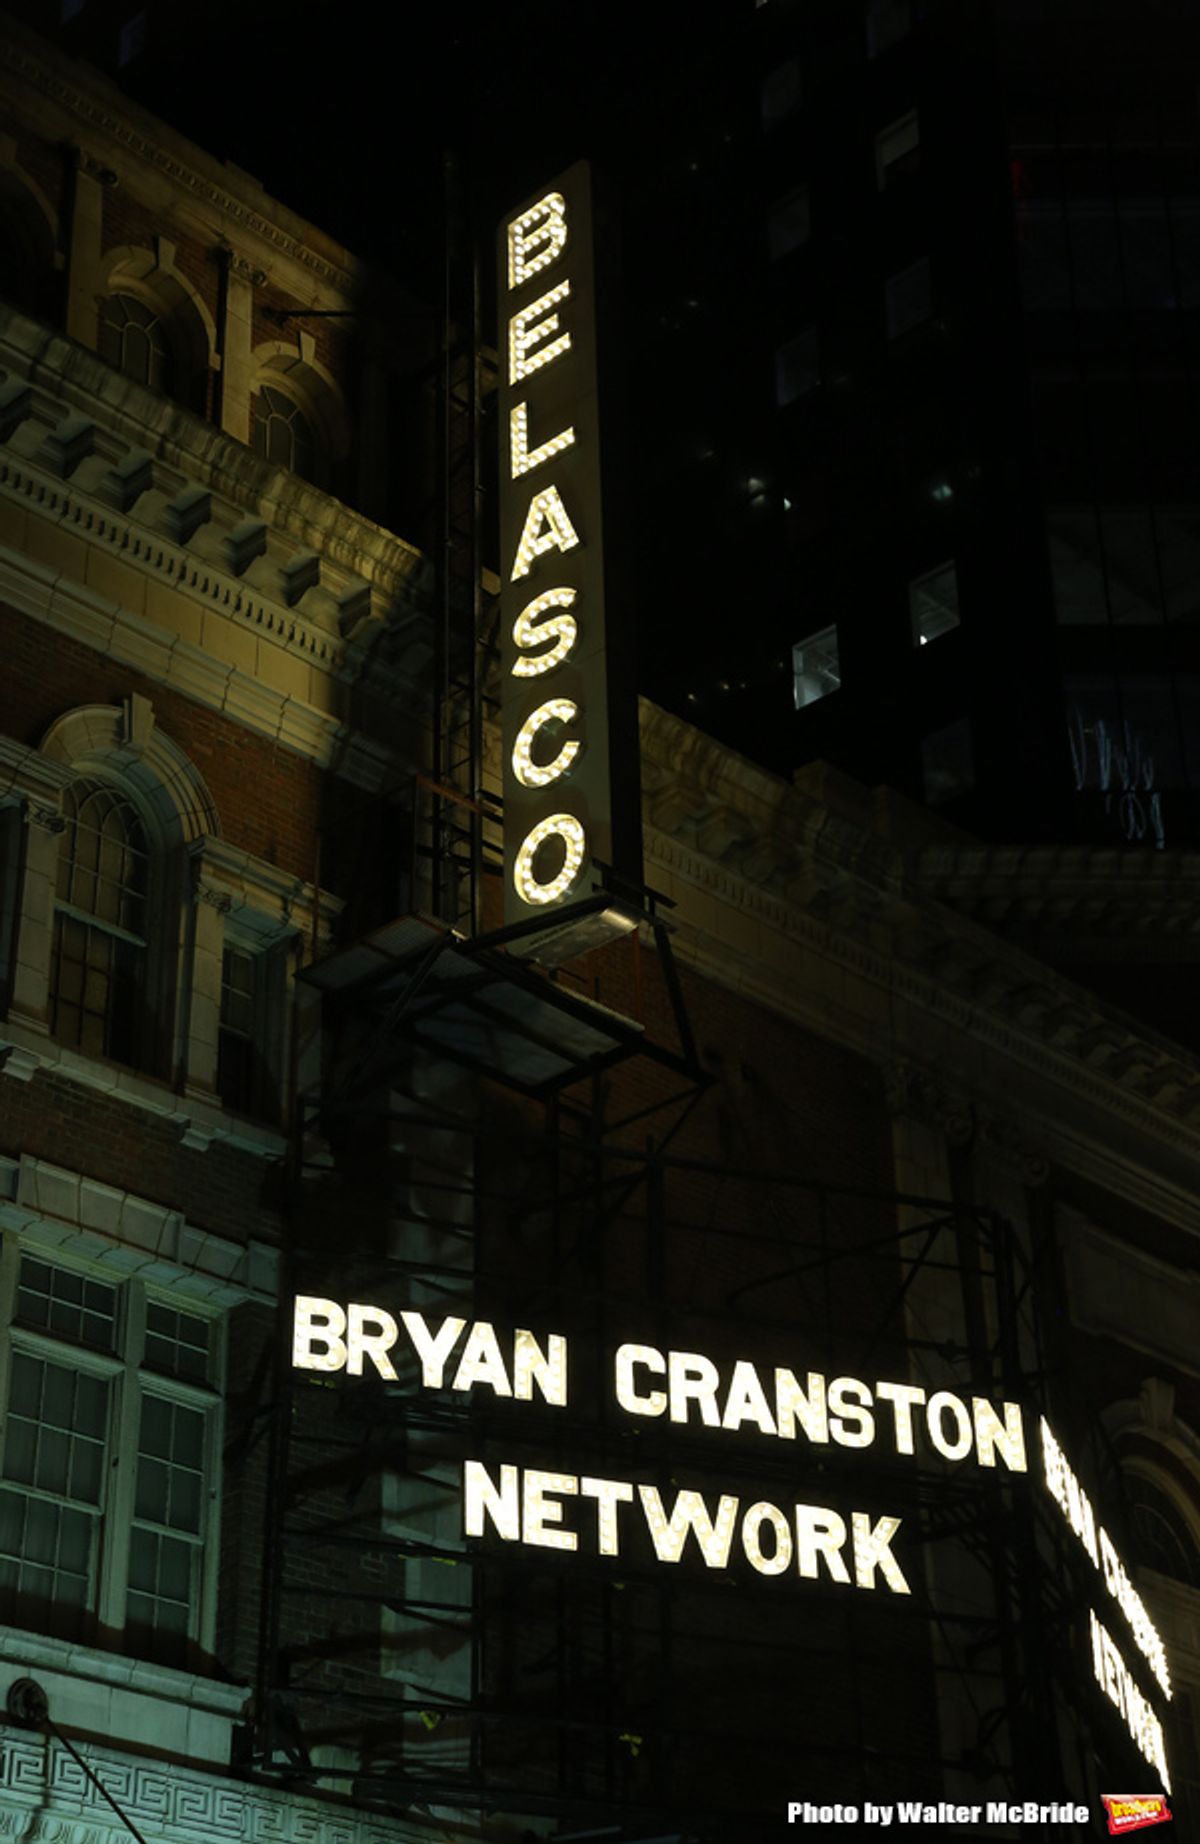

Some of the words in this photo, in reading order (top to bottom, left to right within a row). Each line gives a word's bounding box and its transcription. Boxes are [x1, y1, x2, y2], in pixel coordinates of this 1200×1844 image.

[507, 191, 586, 906] BELASCO
[292, 1295, 567, 1408] BRYAN
[615, 1343, 1028, 1473] CRANSTON
[464, 1459, 913, 1596] NETWORK
